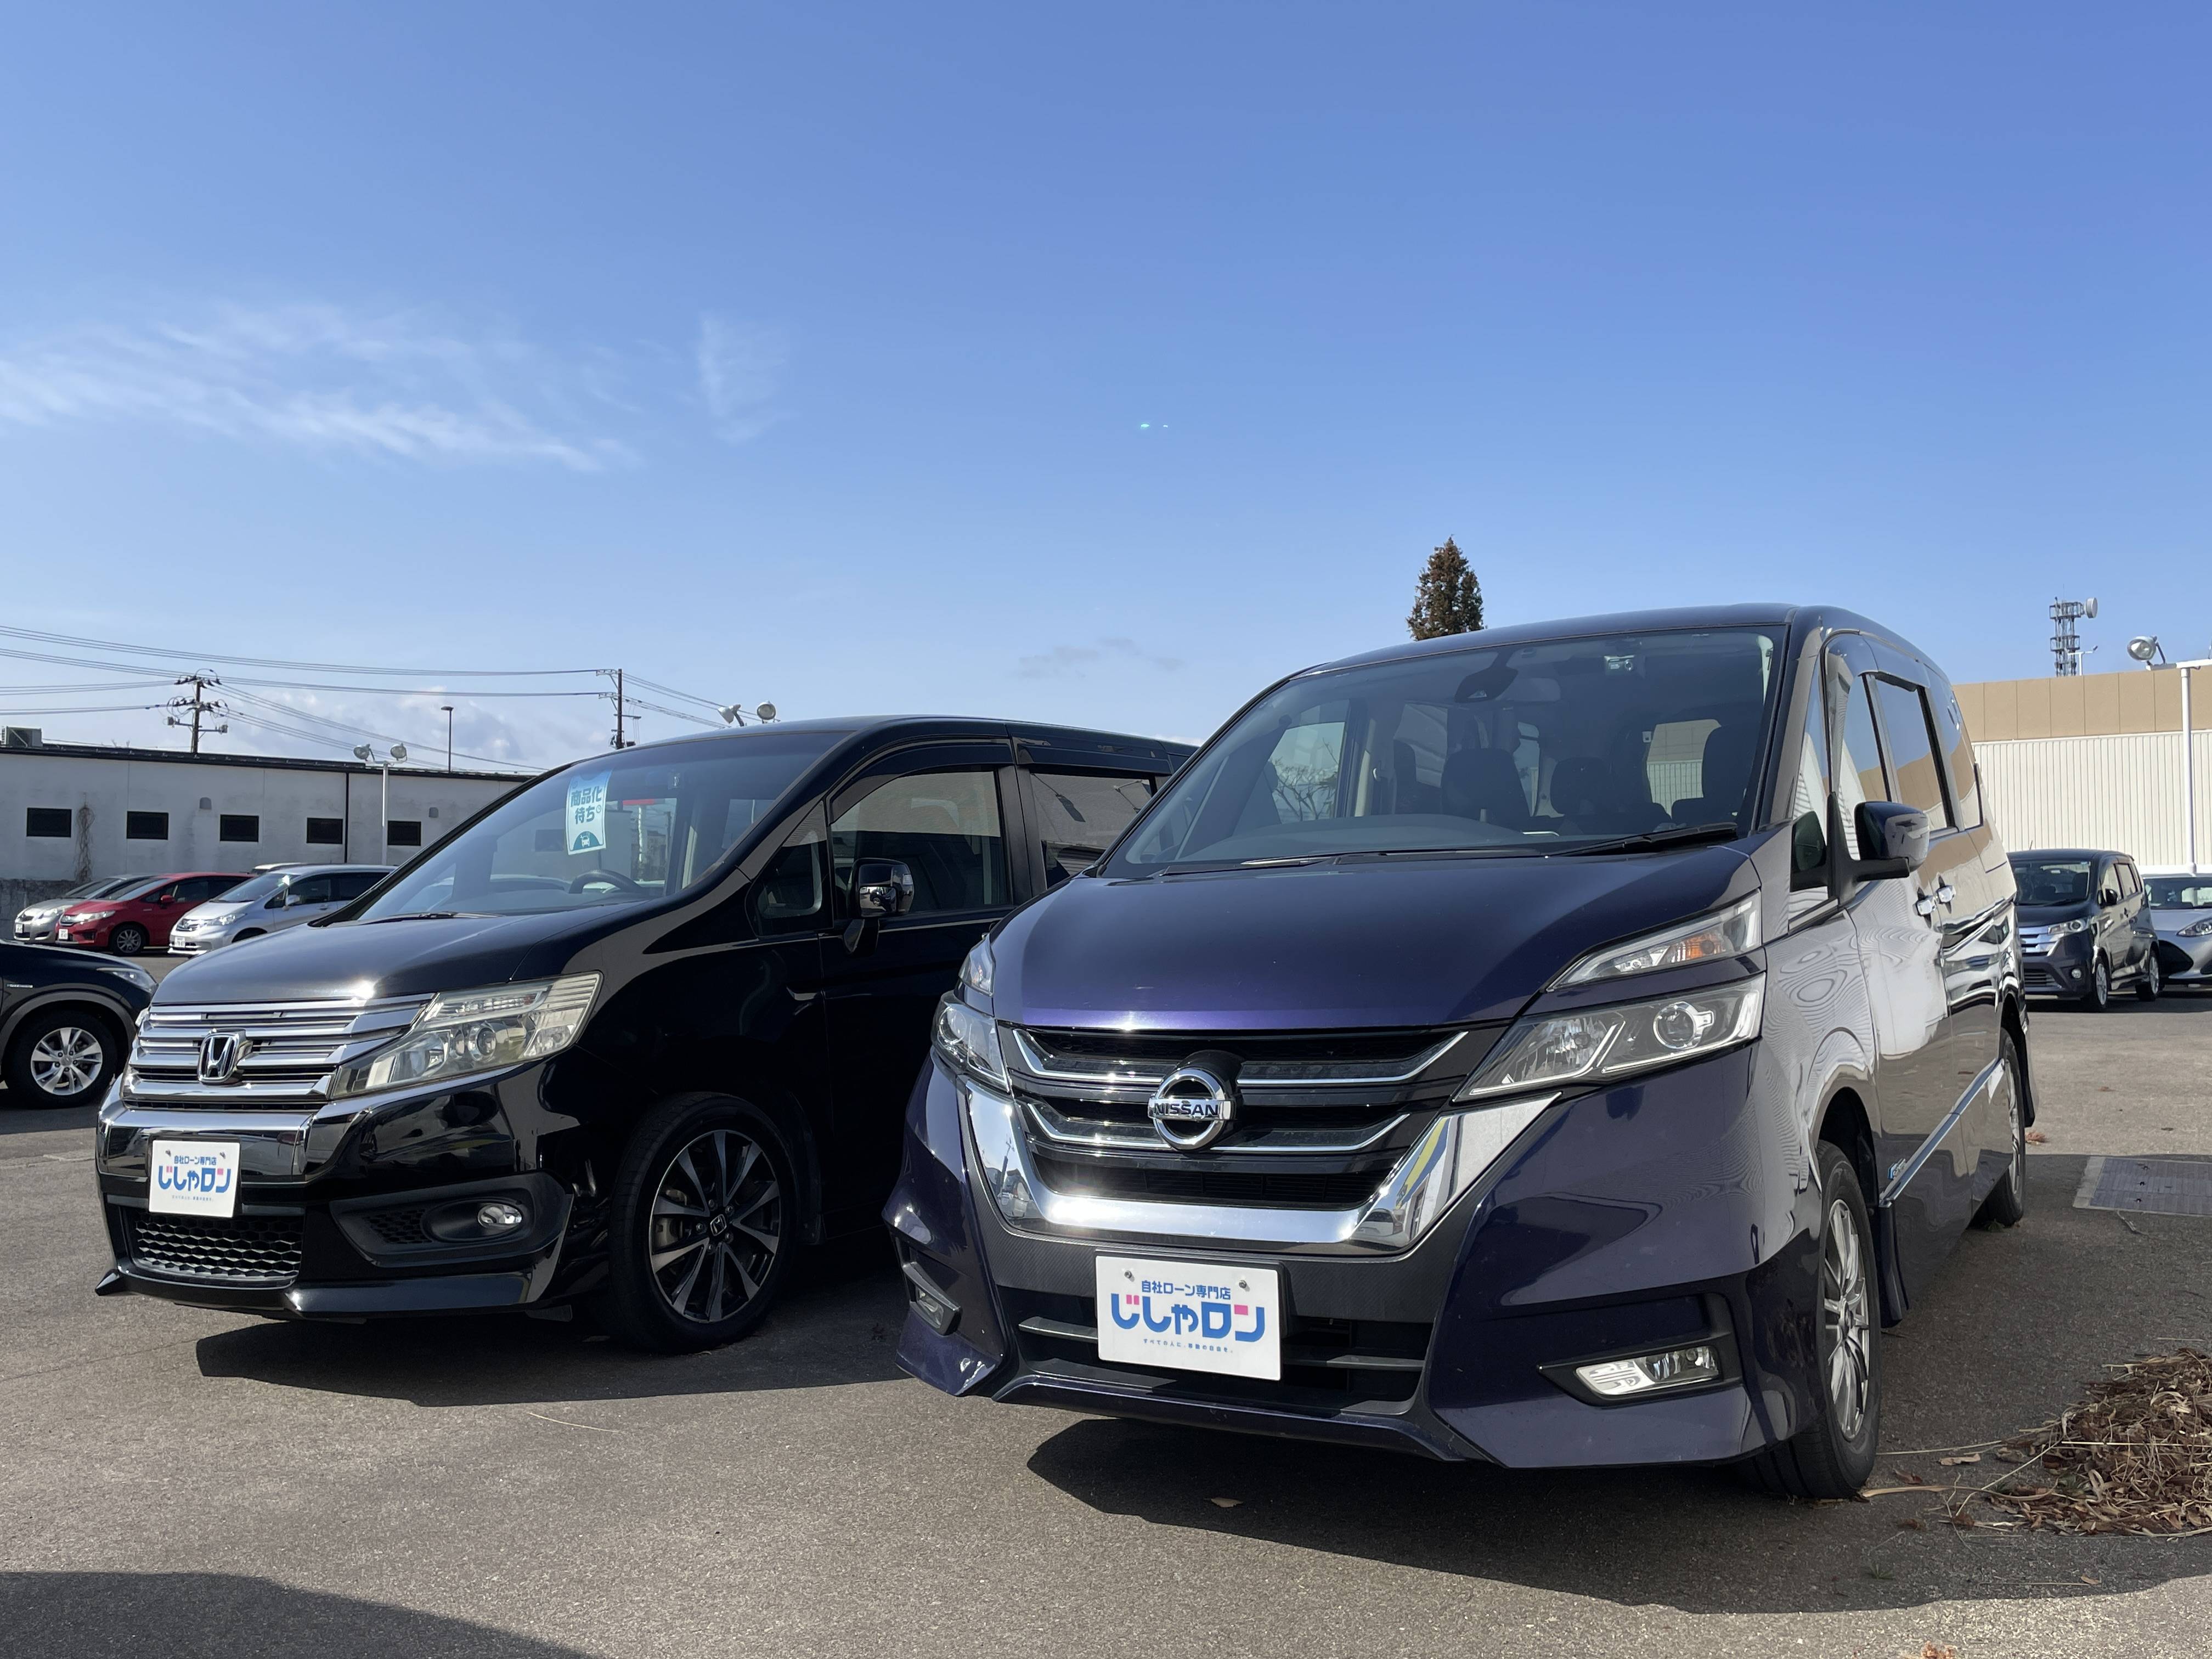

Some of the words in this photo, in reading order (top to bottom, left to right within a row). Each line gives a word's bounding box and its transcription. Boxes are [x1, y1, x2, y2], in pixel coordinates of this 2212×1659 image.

[571, 786, 602, 808] 商品化
[574, 805, 595, 825] 待ち
[1154, 1102, 1218, 1116] NISSAN
[174, 1155, 217, 1166] 自社ローン専門店
[158, 1165, 232, 1193] じしゃロン
[1141, 1280, 1231, 1300] 自社ローン専門店
[1111, 1293, 1265, 1342] じしゃロン
